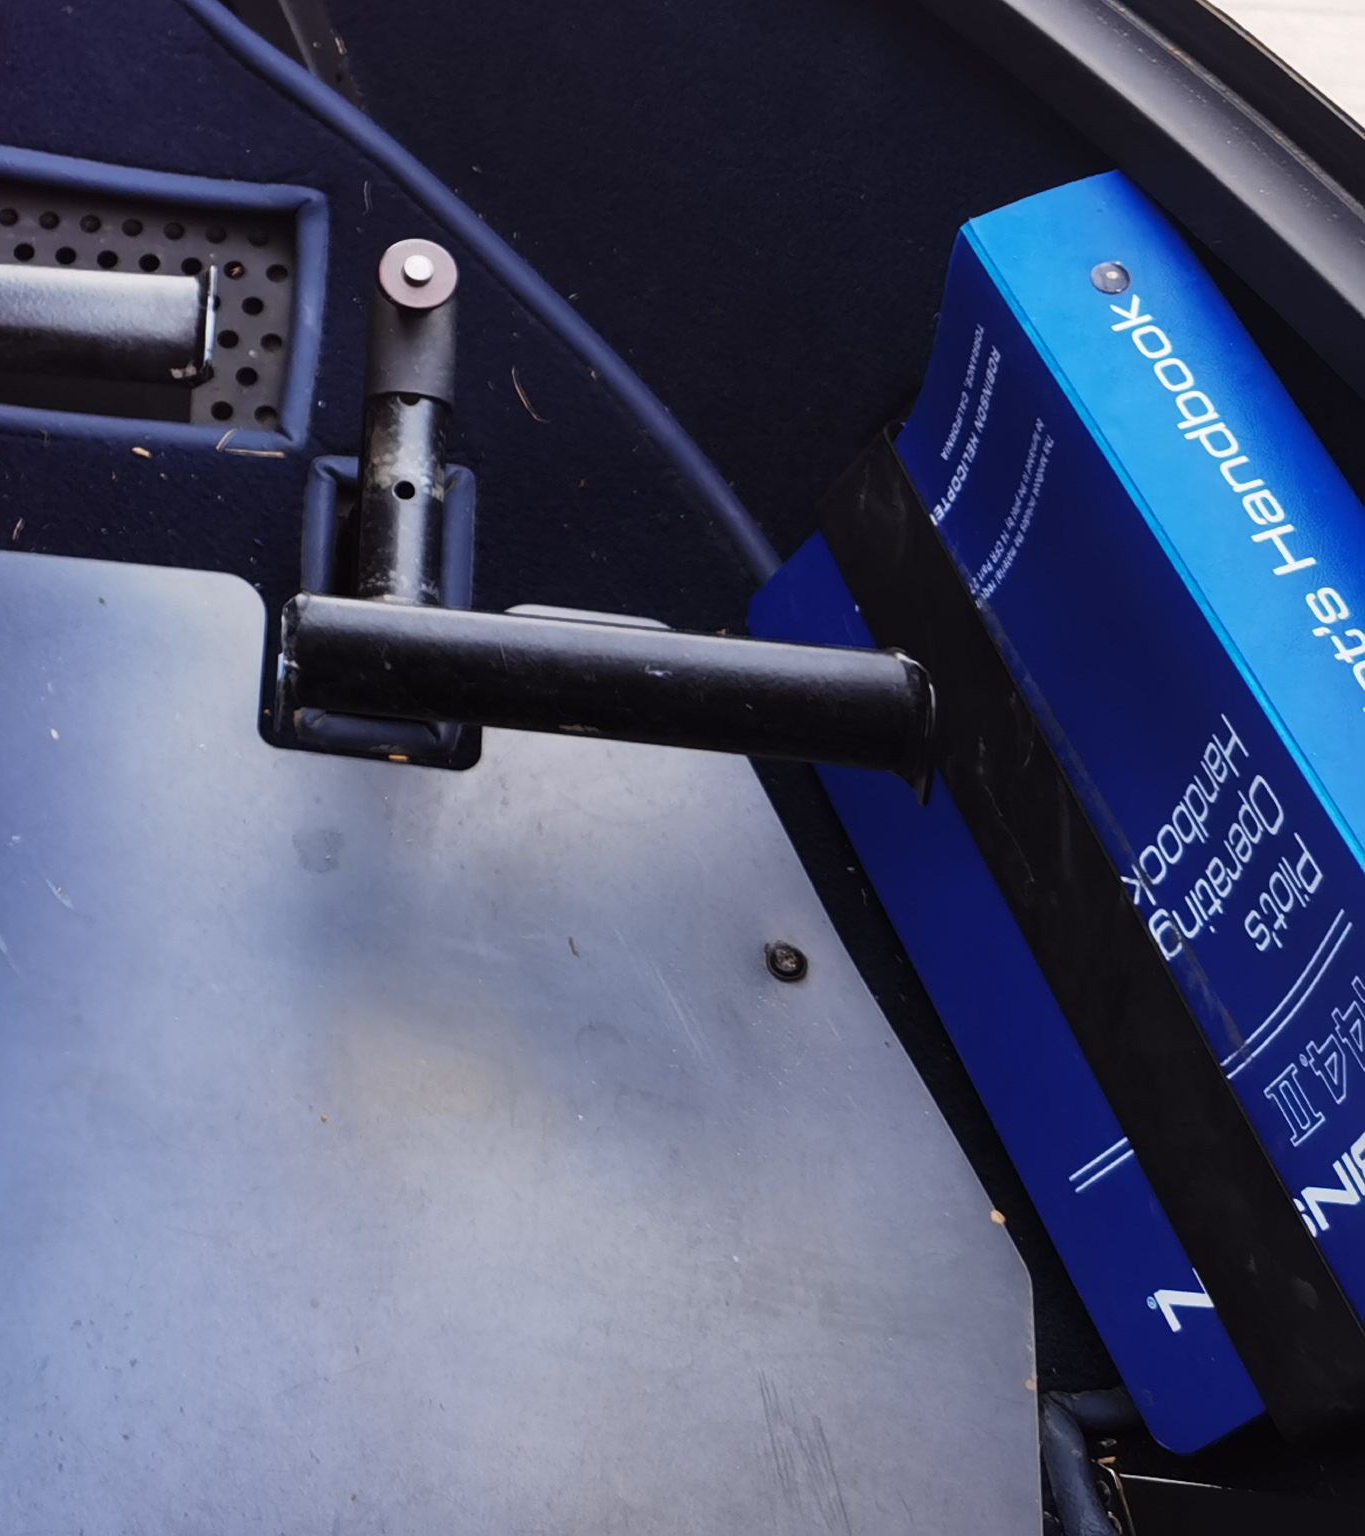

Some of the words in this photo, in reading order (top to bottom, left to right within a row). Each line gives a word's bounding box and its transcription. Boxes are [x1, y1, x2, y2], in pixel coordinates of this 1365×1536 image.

[974, 345, 1001, 432] ROBINSON
[1110, 294, 1317, 576] Handbook
[1121, 714, 1249, 905] Handbook
[1148, 775, 1283, 961] Operating
[1245, 833, 1323, 952] Pilot's
